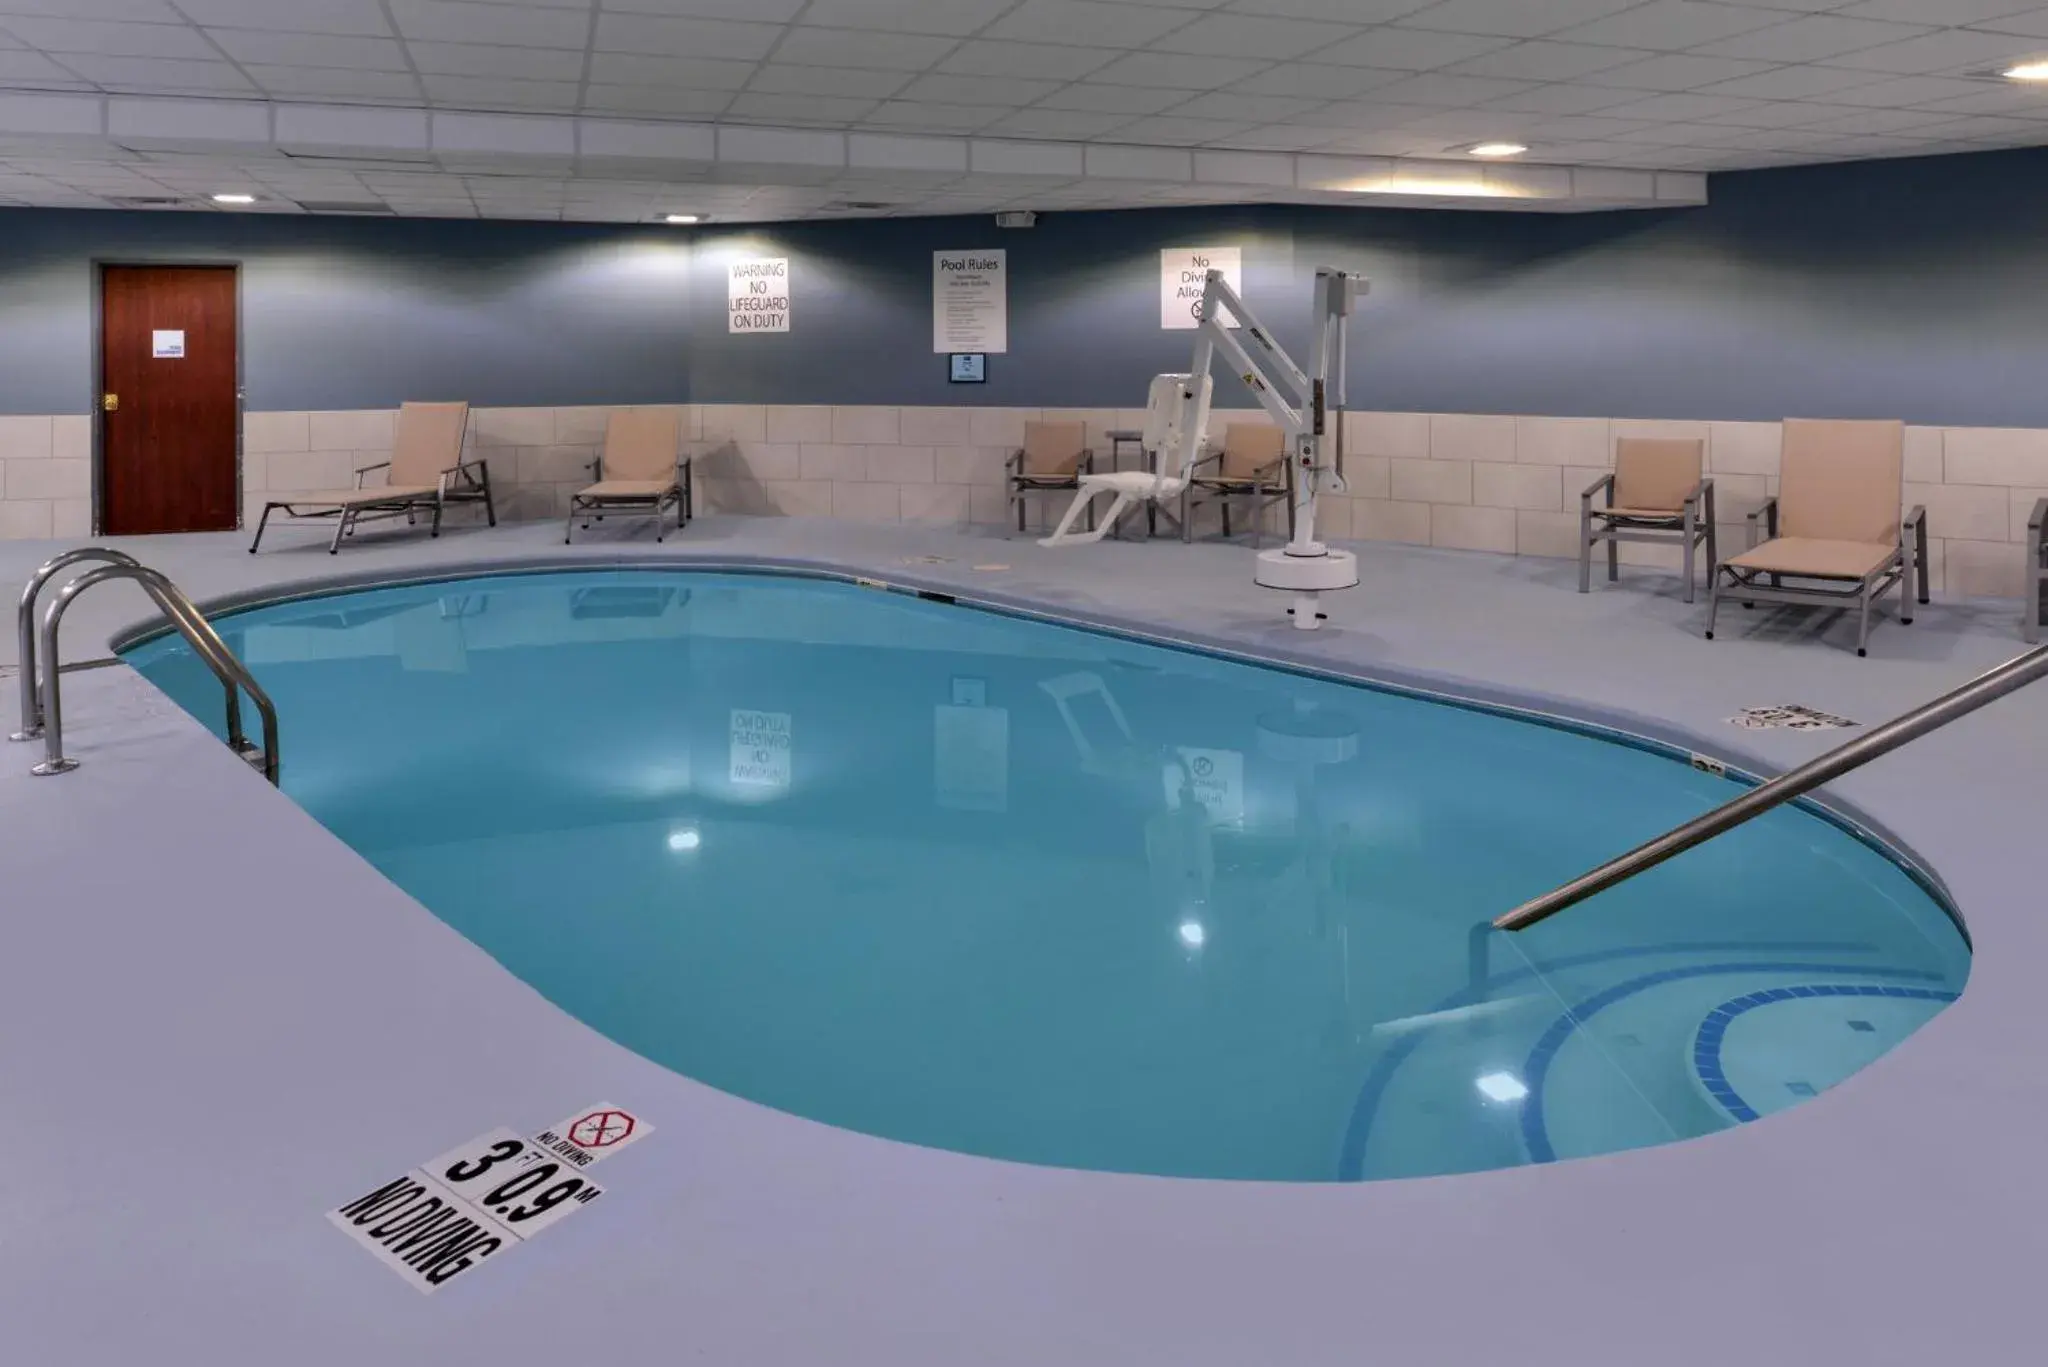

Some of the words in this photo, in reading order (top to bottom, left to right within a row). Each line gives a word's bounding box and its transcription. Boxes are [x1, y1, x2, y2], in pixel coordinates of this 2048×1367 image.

[941, 259, 965, 270] Pool
[968, 258, 998, 270] Rules
[1192, 255, 1210, 267] No
[733, 264, 784, 278] WARNING
[1181, 271, 1206, 283] Divi
[751, 281, 767, 294] NO
[1177, 286, 1206, 299] Allo
[730, 297, 788, 311] LIFEGUARD
[735, 315, 751, 328] ON
[755, 314, 784, 328] DUTY
[536, 1131, 559, 1145] NO
[551, 1140, 594, 1167] DIVING
[445, 1139, 525, 1182] 3
[482, 1163, 585, 1223] 0.9
[573, 1185, 602, 1204] M
[338, 1175, 427, 1226] NO
[367, 1196, 502, 1286] DIVING
